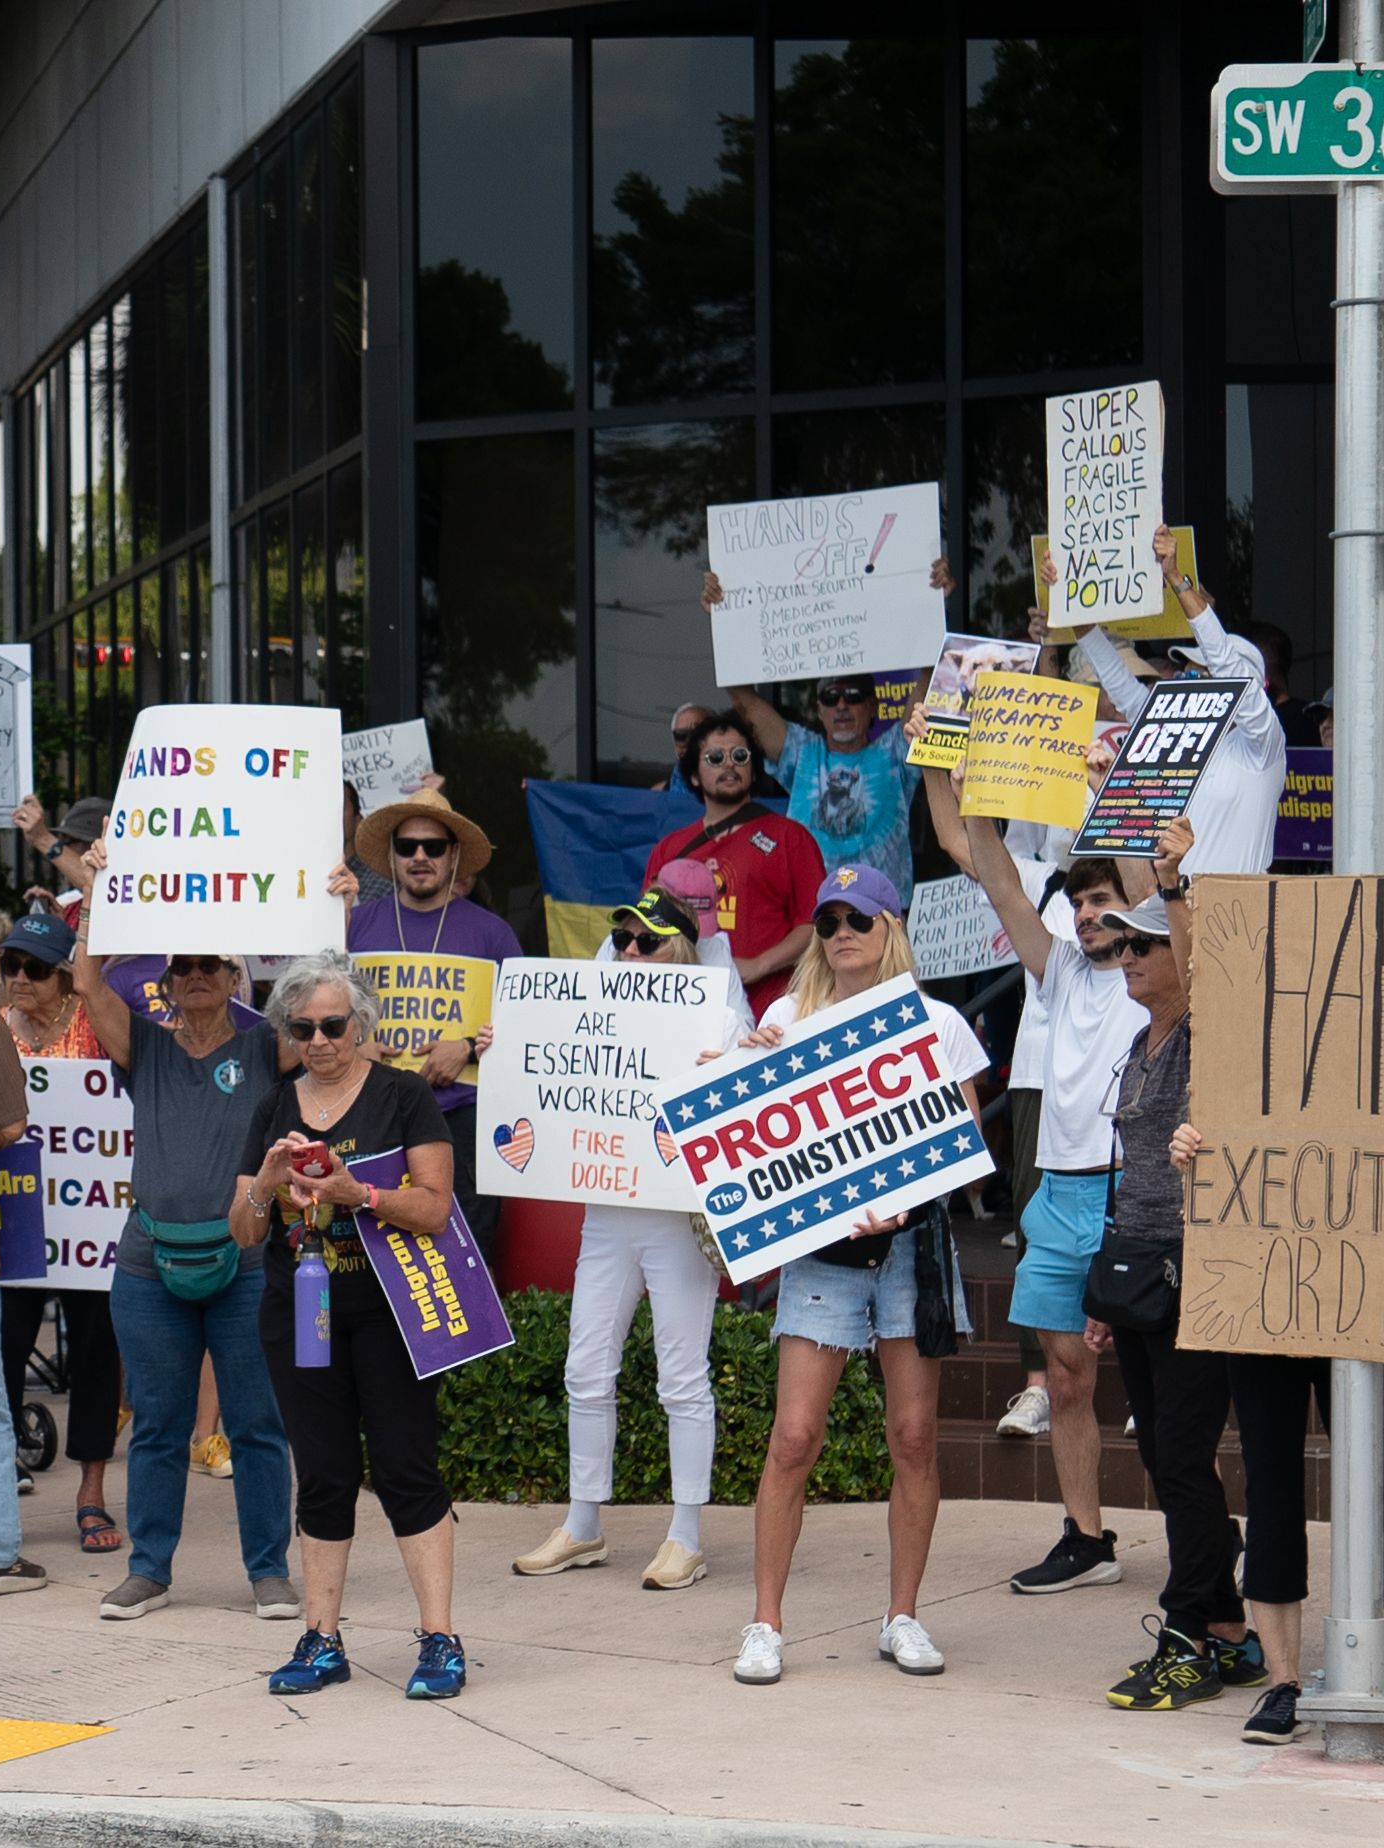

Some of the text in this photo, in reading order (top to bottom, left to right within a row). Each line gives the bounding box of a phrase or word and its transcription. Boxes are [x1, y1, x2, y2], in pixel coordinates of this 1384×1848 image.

[1232, 99, 1306, 156] SW
[1061, 387, 1145, 433] SUPER
[1061, 427, 1148, 462] CALLOUS
[1064, 456, 1146, 493] FRAGILE
[1064, 485, 1148, 522] RACIST
[718, 495, 864, 553] HANDS
[1060, 514, 1141, 550] SEXIST
[1065, 545, 1136, 581] NAZI
[768, 583, 808, 602] SOCIAL
[811, 577, 865, 598] SECURITY
[1066, 571, 1148, 613] POTUS
[772, 600, 836, 625] MEDICARE
[809, 631, 860, 654] BODIES
[818, 651, 865, 671] PLANET
[976, 685, 1084, 713] CUMENTED
[1145, 692, 1235, 720] HANDS
[341, 728, 394, 752] CURITY
[912, 748, 959, 762] My Social
[969, 729, 1086, 757] LIONS IN TAXES
[1126, 721, 1218, 763] OFF!
[124, 747, 309, 780] HANDS OFF
[343, 750, 394, 776] RKERS
[1033, 765, 1085, 783] MEDICARE
[355, 774, 379, 792] RE
[990, 775, 1044, 791] SECURITY
[114, 807, 240, 839] SOCIAL
[107, 872, 276, 904] SECURITY
[917, 894, 981, 925] WORKER
[913, 913, 985, 947] RUN THIS
[920, 935, 988, 962] OUNTRY!
[358, 965, 466, 992] WE MAKE
[917, 961, 948, 977] TECT
[499, 970, 708, 1006] FEDERAL WORKERS
[379, 996, 463, 1023] MERICA
[575, 1012, 617, 1037] ARE
[374, 1027, 444, 1051] WORK
[524, 1042, 660, 1080] ESSENTIAL
[538, 1084, 658, 1121] WORKERS
[681, 1032, 941, 1186] PROTECT
[572, 1128, 626, 1158] FIRE
[709, 1080, 968, 1211] The CONSTITUTION
[571, 1162, 640, 1199] DOGE!
[387, 1232, 441, 1333] Imigran
